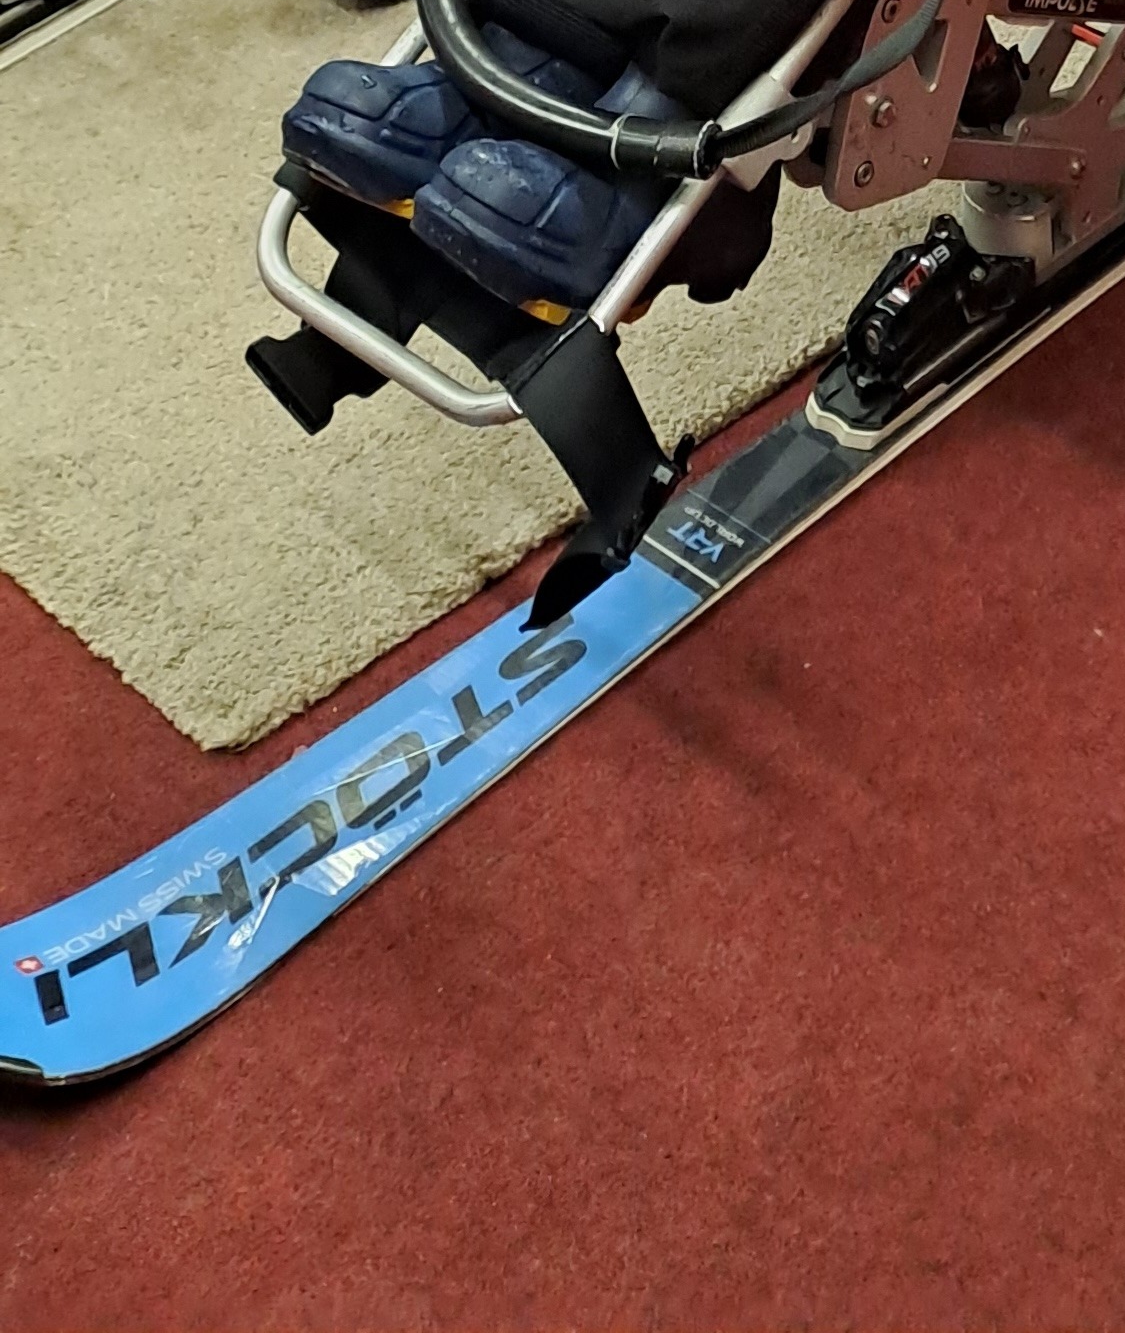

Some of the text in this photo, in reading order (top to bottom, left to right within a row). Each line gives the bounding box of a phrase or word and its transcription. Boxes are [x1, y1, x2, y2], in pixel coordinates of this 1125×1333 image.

[33, 612, 588, 1025] STÖCKLI
[42, 845, 228, 966] SWISS MADE
